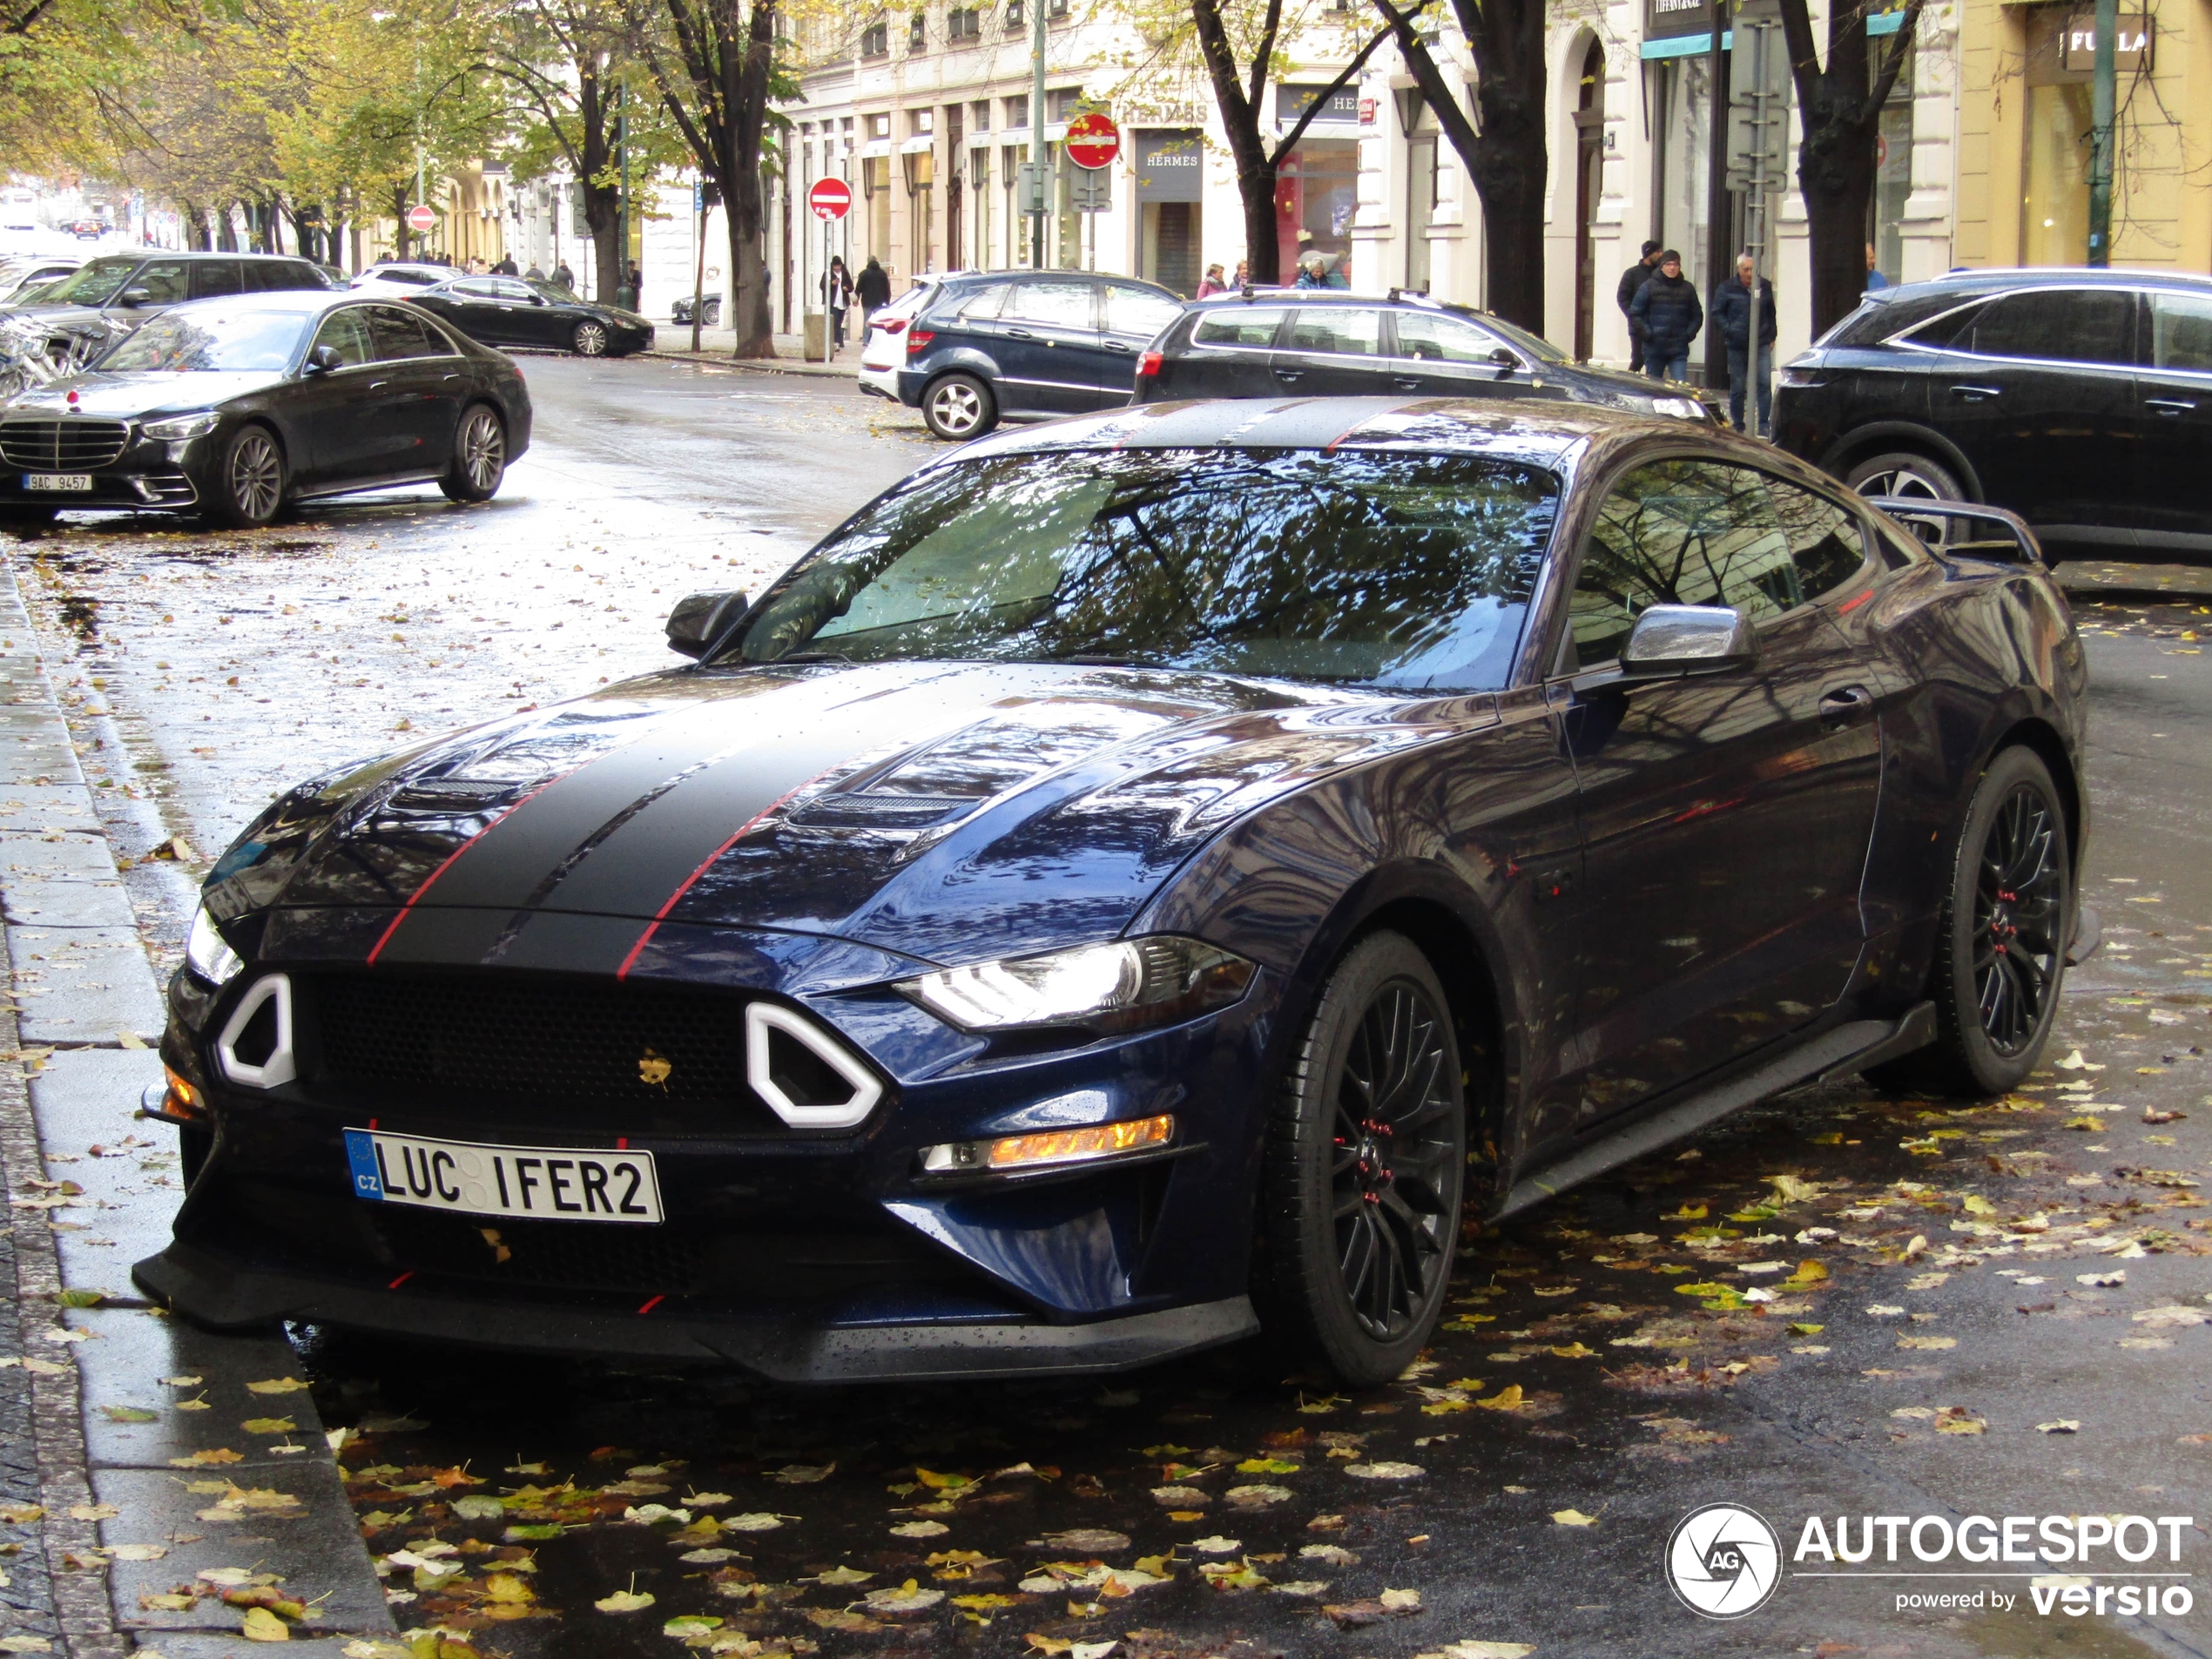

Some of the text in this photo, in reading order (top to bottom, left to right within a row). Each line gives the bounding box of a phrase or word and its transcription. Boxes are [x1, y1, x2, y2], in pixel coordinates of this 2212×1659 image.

[2070, 31, 2148, 51] FULA
[1333, 97, 1359, 110] HE
[31, 476, 86, 489] 9AC 9457
[357, 1174, 379, 1191] CZ
[374, 1142, 648, 1214] LUC IFER2
